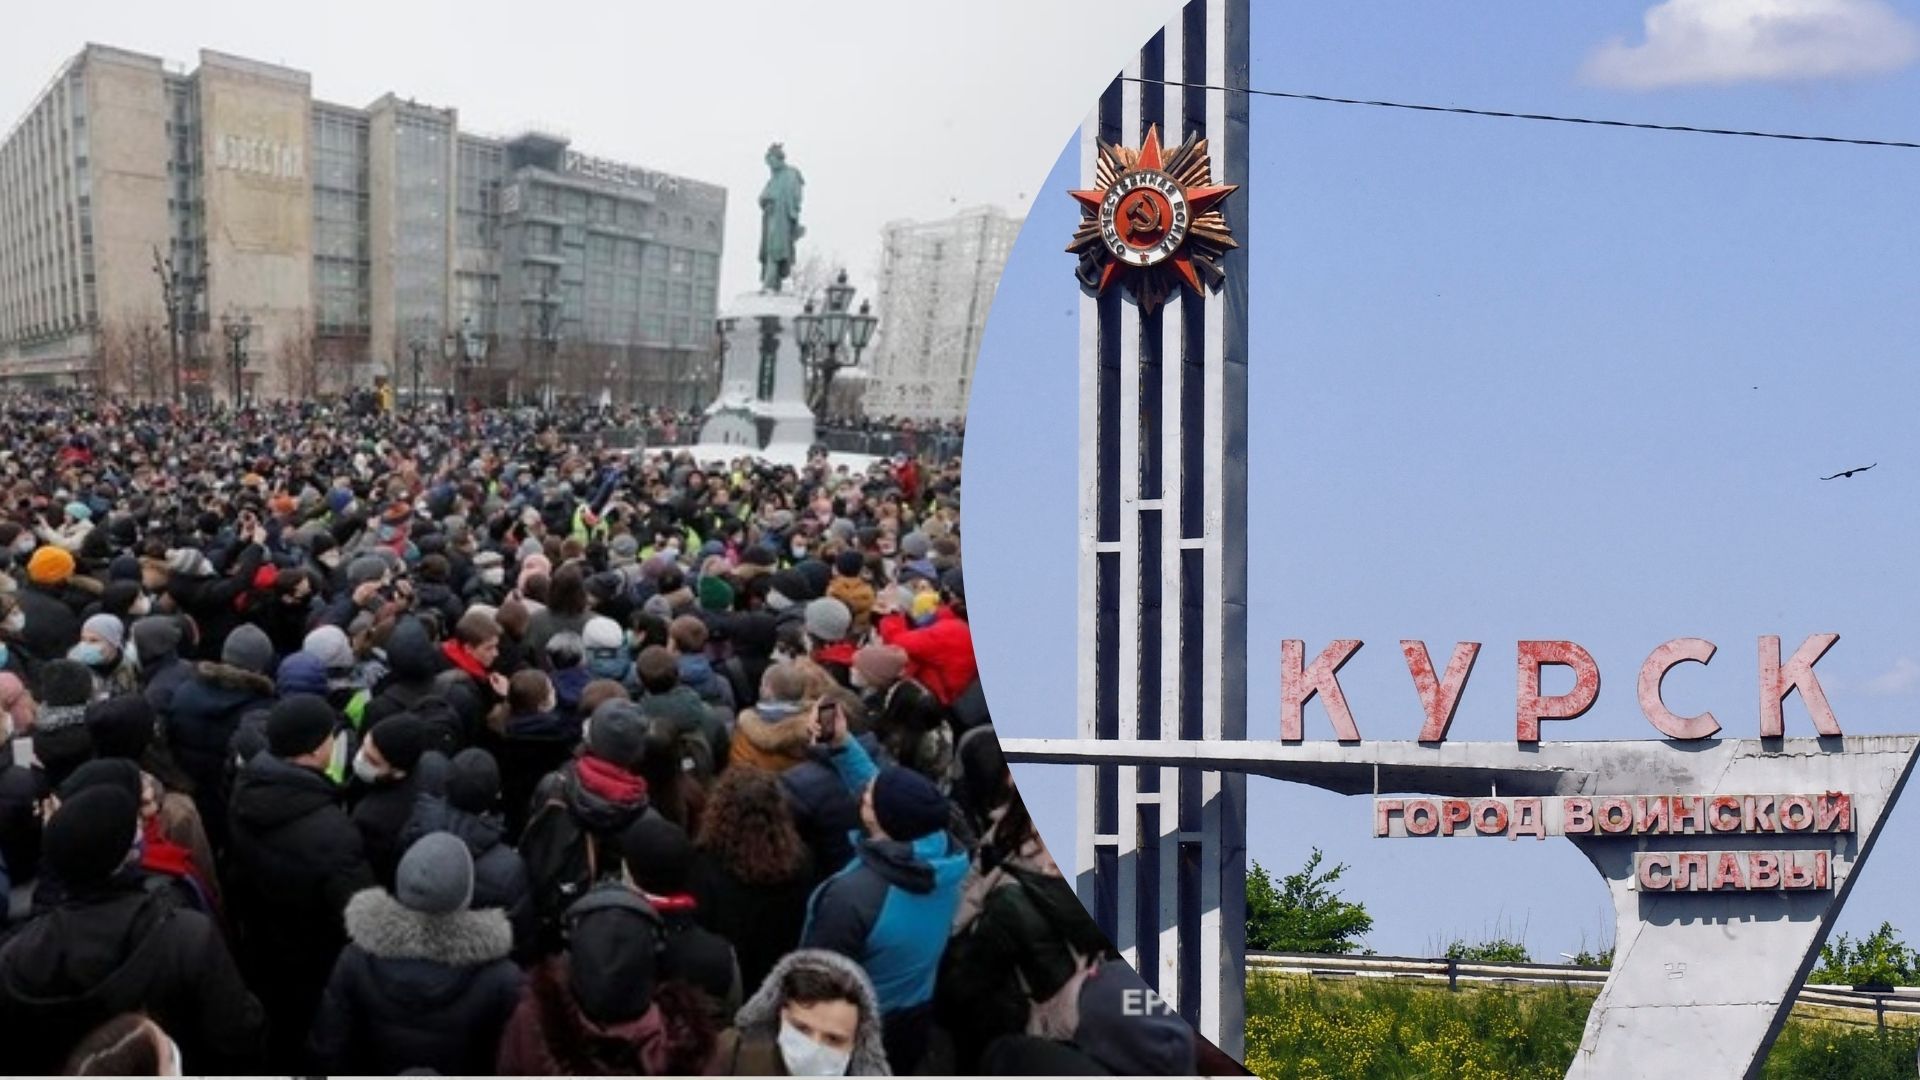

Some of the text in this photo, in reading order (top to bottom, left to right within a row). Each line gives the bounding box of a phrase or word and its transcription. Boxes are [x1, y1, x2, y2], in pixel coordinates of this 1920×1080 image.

[1280, 633, 1843, 742] КУРСК
[1376, 790, 1853, 841] ГОРОД ВОИНСКОЙ
[1638, 852, 1829, 890] СЛАВЫ
